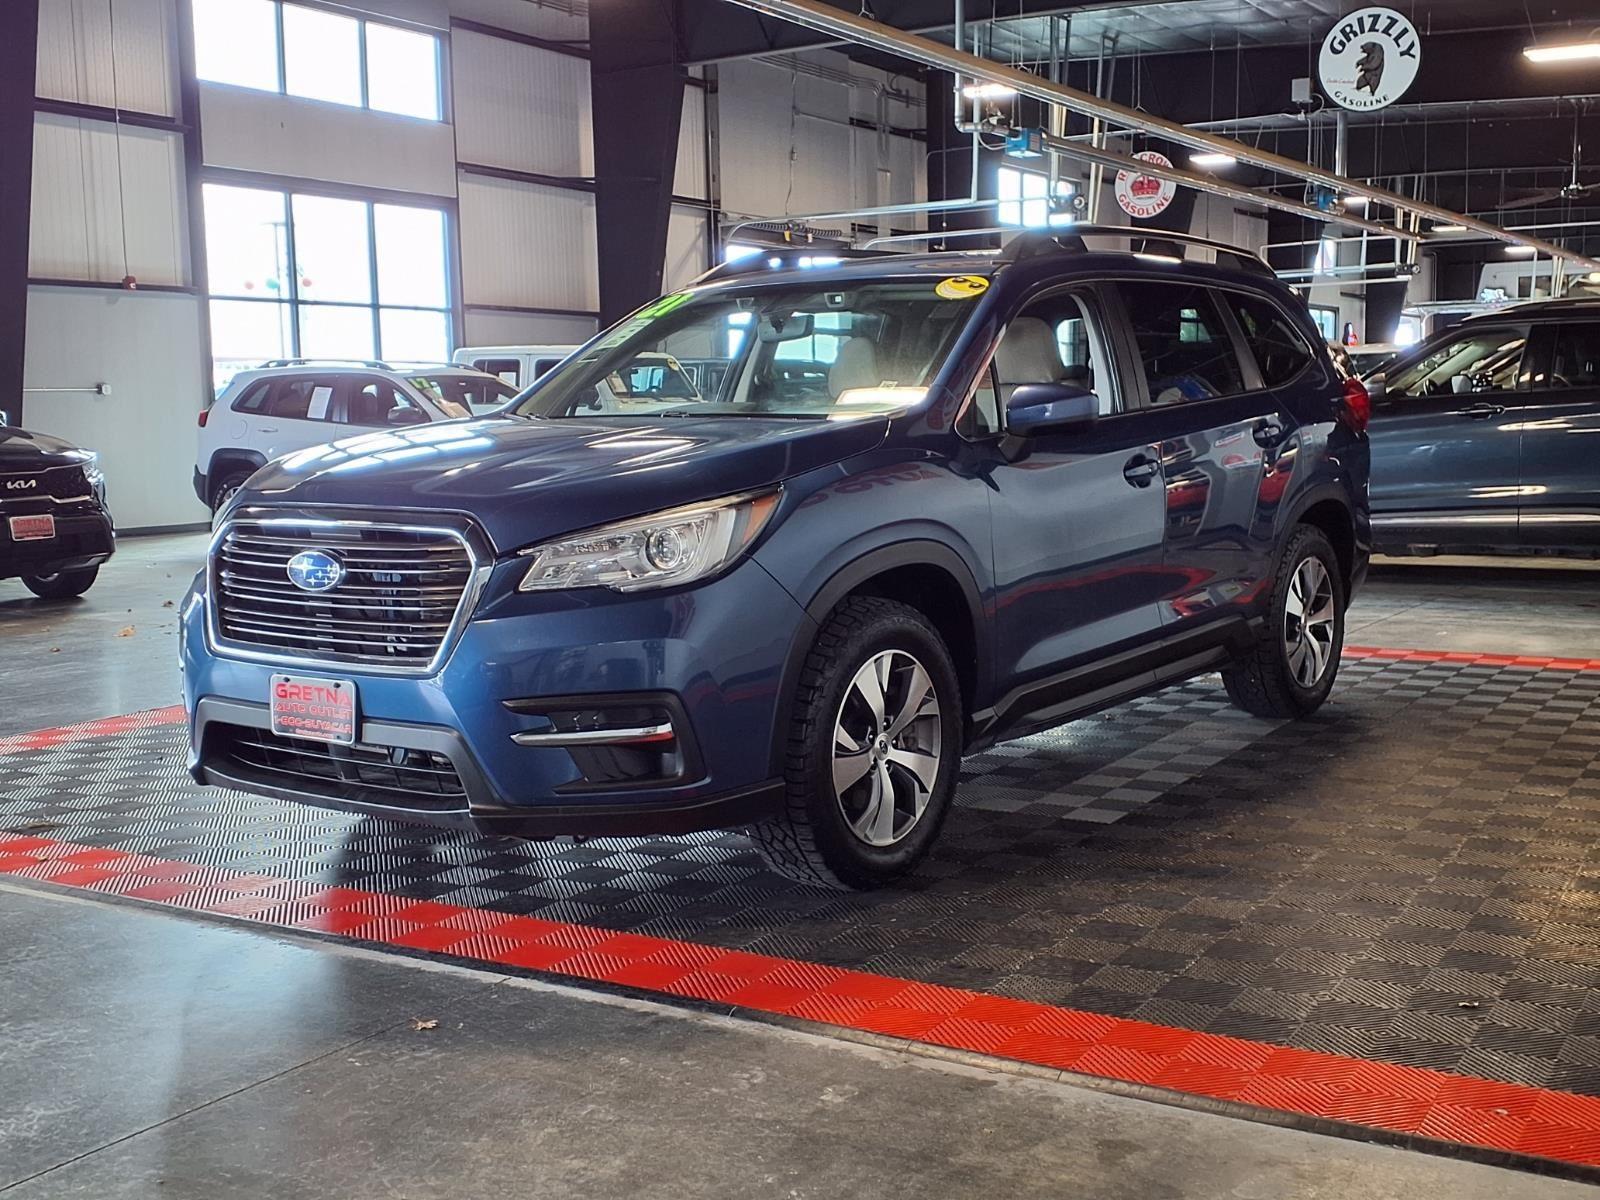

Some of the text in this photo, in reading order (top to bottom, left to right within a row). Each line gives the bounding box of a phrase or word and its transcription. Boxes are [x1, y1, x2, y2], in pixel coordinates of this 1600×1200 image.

[1329, 13, 1416, 59] GRIZZLY
[1334, 90, 1389, 107] GASOLINE
[1118, 192, 1171, 216] GASOLINE
[6, 479, 37, 489] KIA
[275, 683, 352, 706] GRETNA
[274, 702, 352, 720] AUTO OUTLET
